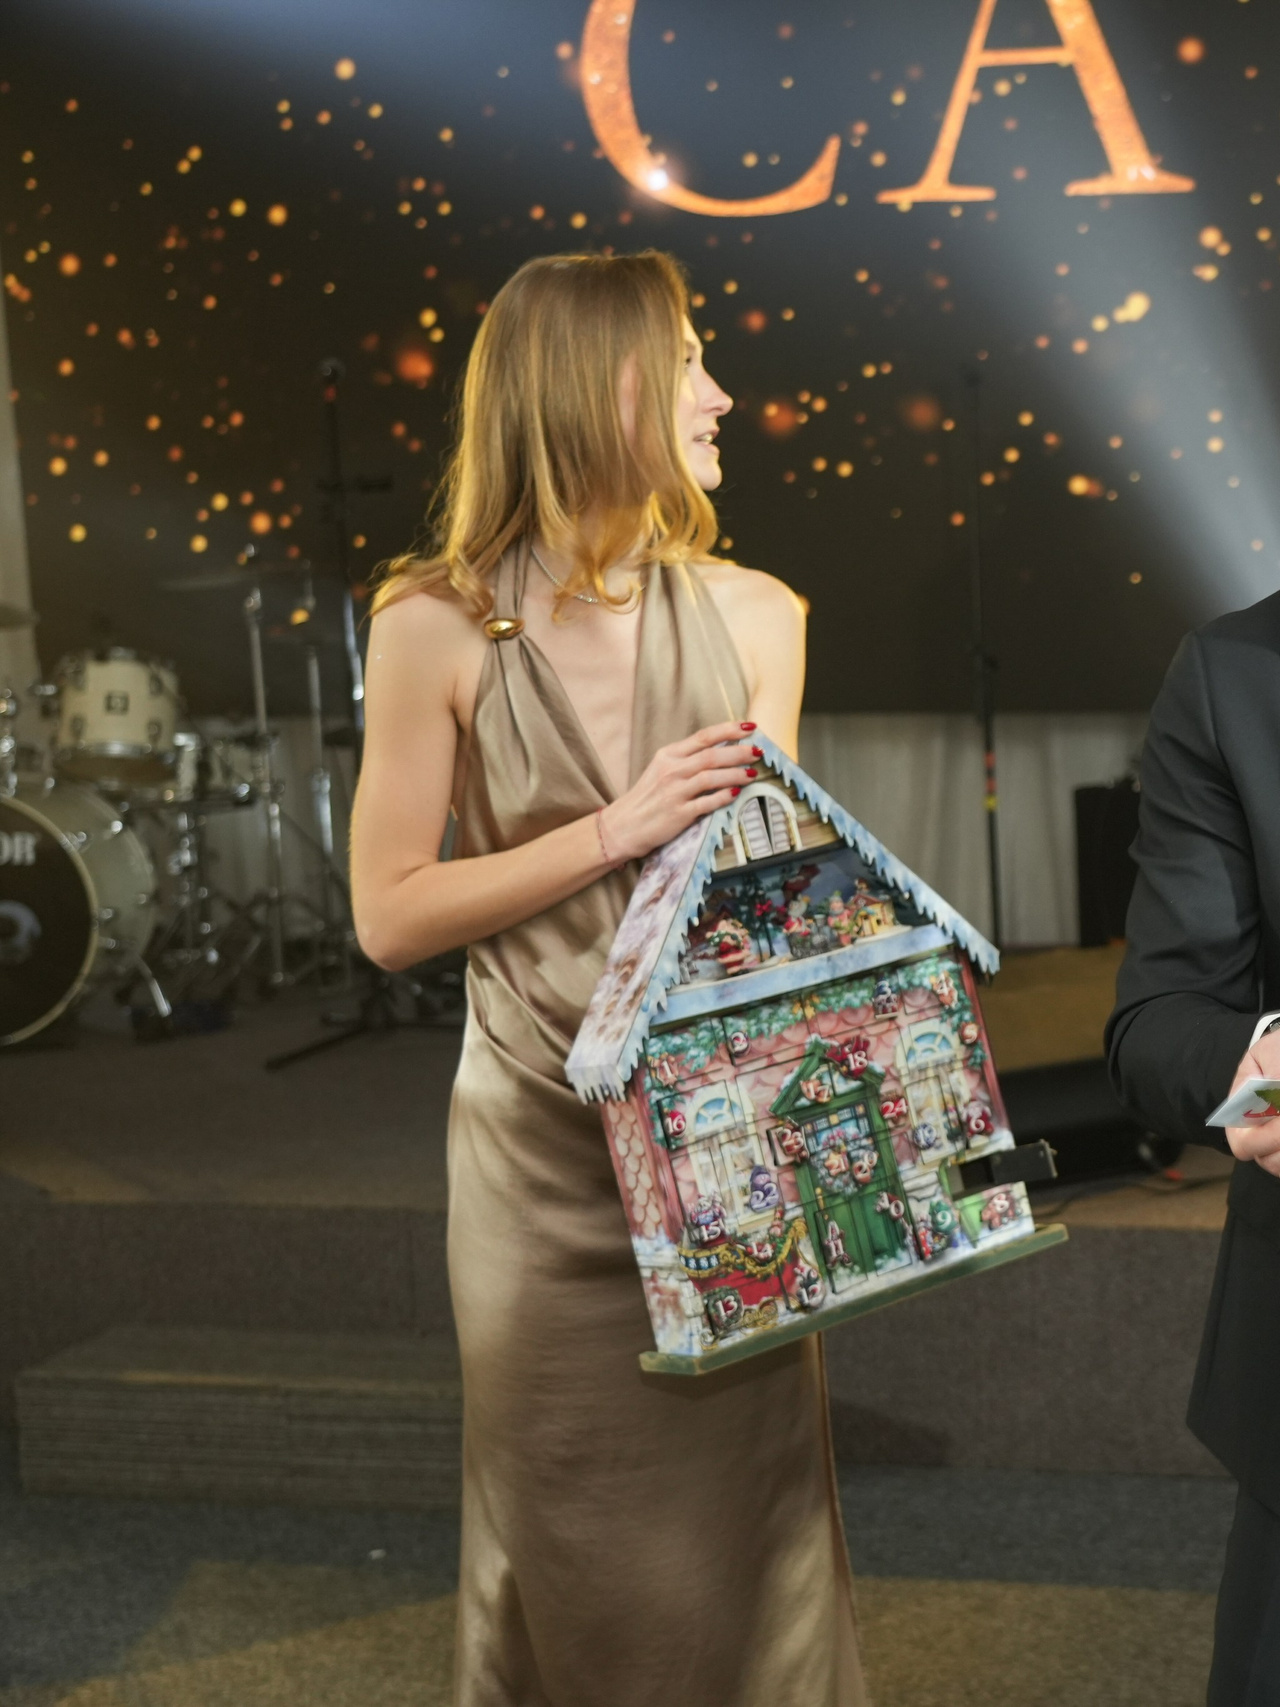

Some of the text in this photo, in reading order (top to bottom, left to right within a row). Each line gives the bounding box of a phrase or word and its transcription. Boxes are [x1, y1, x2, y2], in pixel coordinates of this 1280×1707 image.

[849, 1051, 868, 1069] 18
[881, 1098, 908, 1119] 24
[666, 1117, 686, 1135] 16
[751, 1183, 779, 1210] 22
[937, 1211, 951, 1229] 9
[702, 1222, 721, 1243] 15
[716, 1295, 738, 1321] 13
